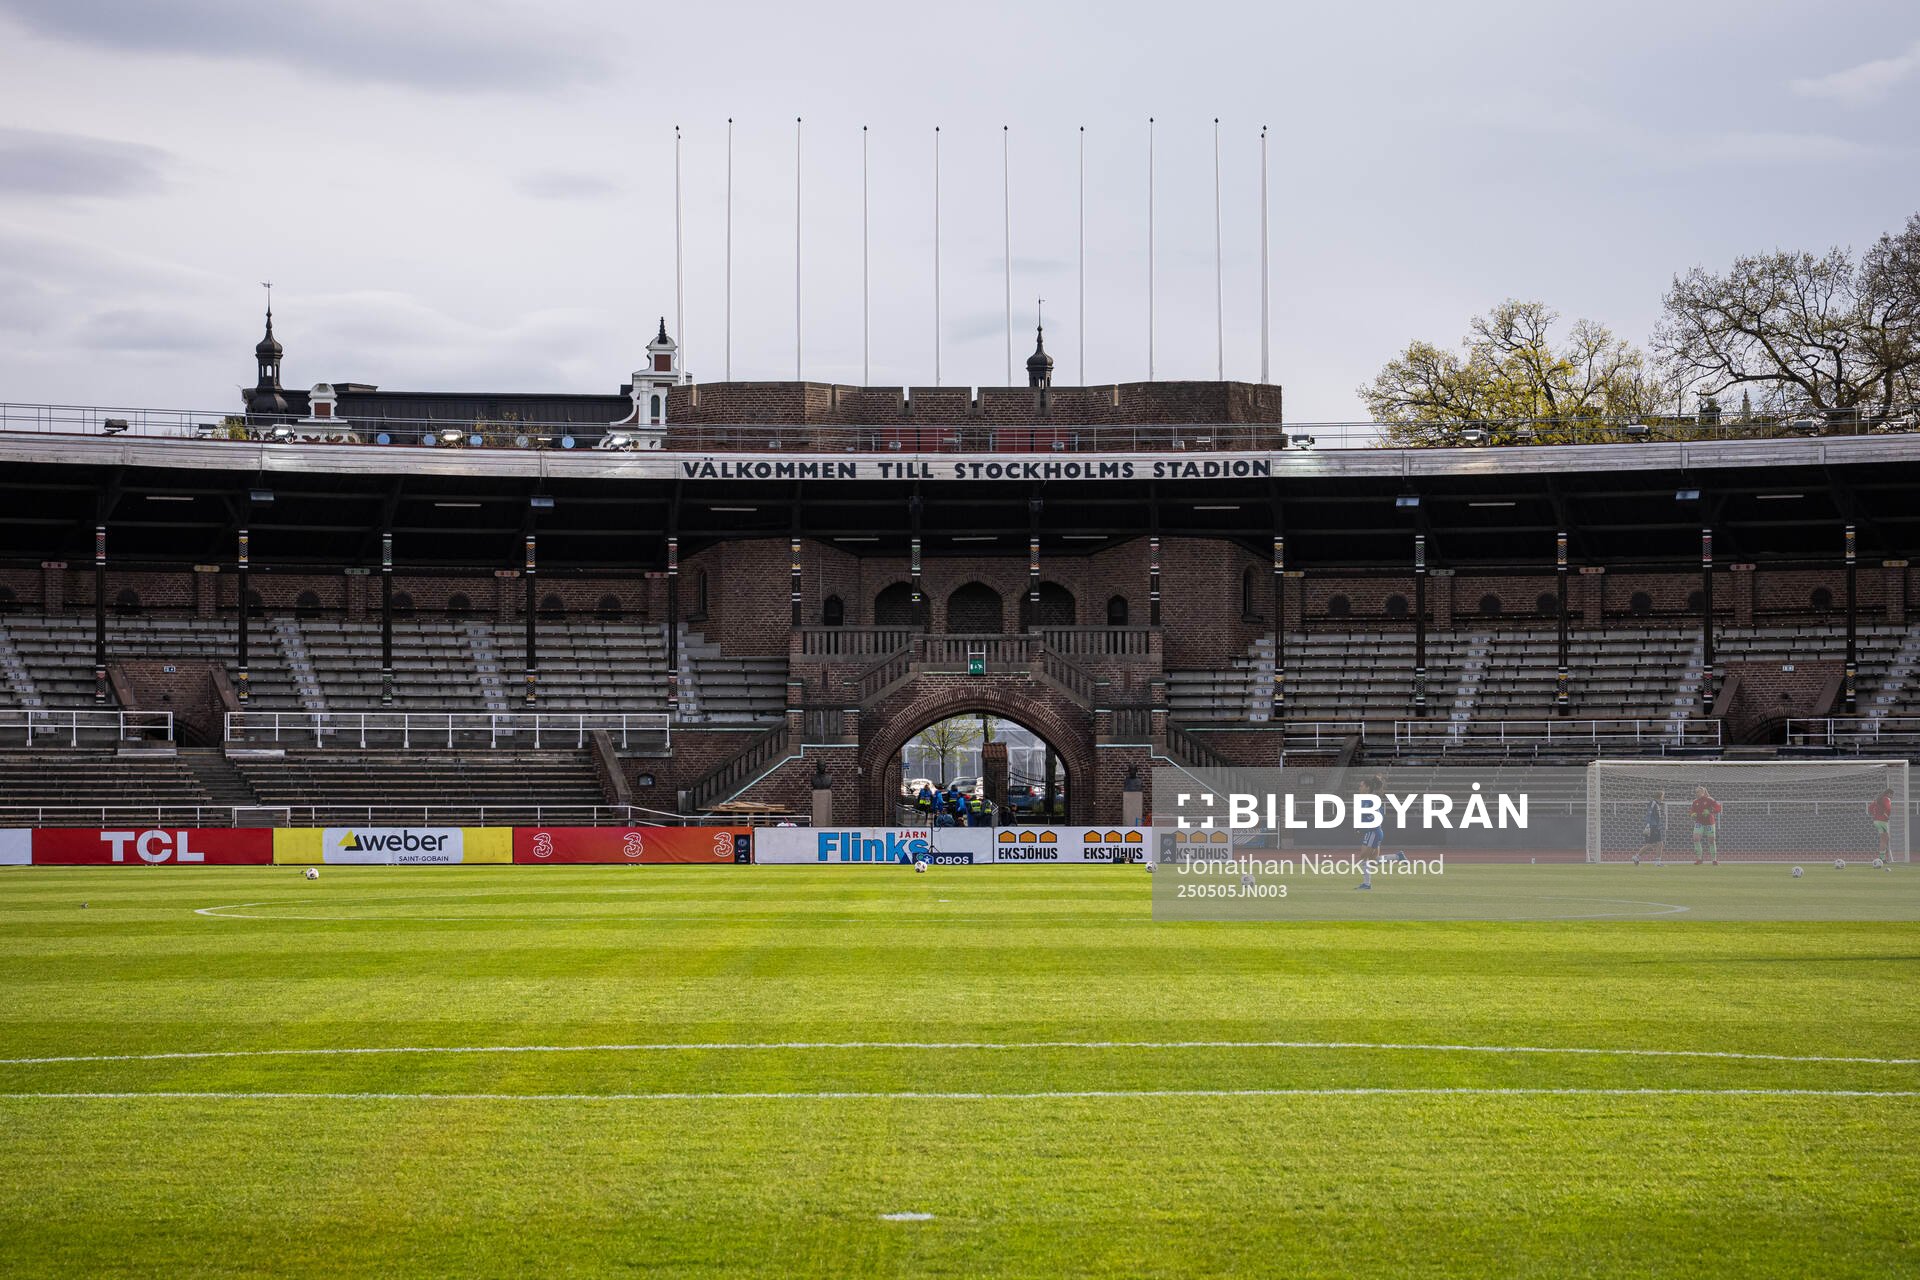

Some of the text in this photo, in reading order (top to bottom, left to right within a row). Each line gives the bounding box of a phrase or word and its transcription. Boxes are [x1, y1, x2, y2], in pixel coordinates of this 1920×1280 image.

[682, 458, 1270, 479] VÄLKOMMEN TILL STOCKHOLMS STADION
[100, 830, 204, 862] TCL
[362, 830, 448, 851] weber
[532, 832, 553, 857] 3
[623, 832, 644, 857] 3
[713, 832, 734, 857] 3
[818, 832, 929, 862] Flinks
[936, 856, 970, 864] OBOS
[998, 845, 1058, 860] EKSJÖHUS
[1084, 845, 1143, 860] EKSJÖHUS
[1176, 846, 1228, 860] KSJÖHUS
